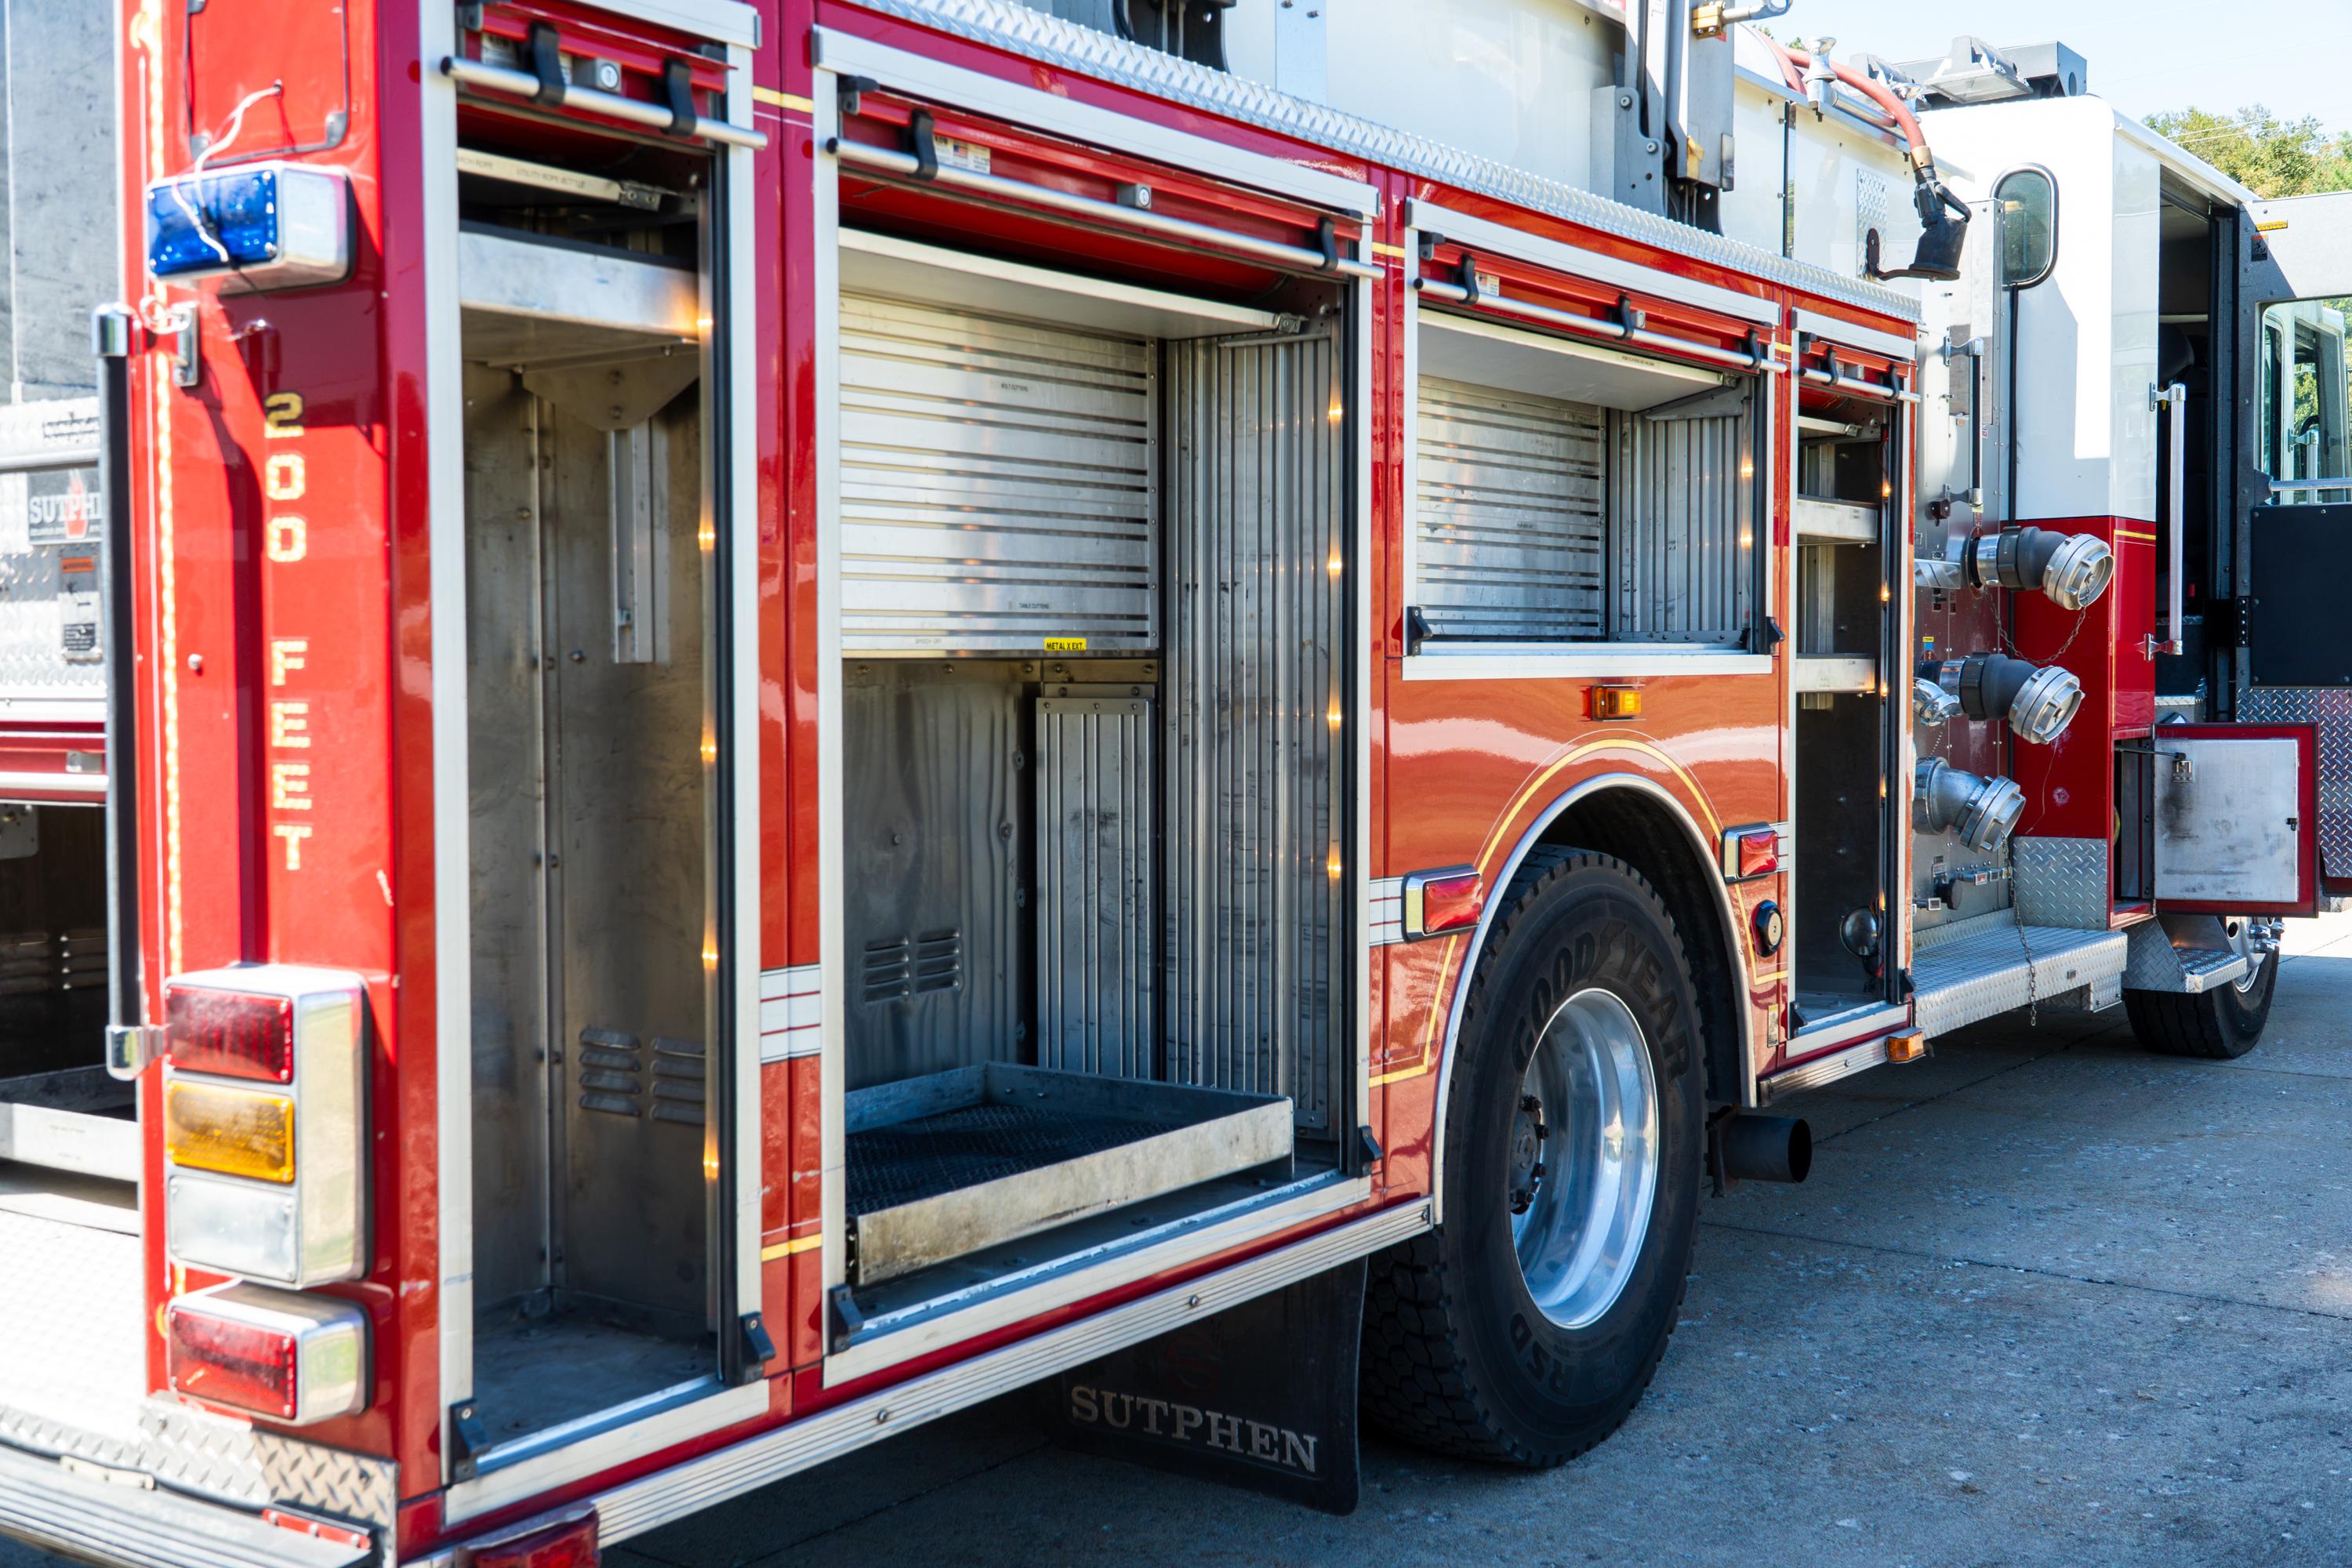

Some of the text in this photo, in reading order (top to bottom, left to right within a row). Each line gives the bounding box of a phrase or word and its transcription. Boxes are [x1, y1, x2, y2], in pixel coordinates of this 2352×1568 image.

[1046, 642, 1065, 651] METAL
[270, 640, 312, 870] FEET
[1071, 1385, 1318, 1472] SUTPHEN
